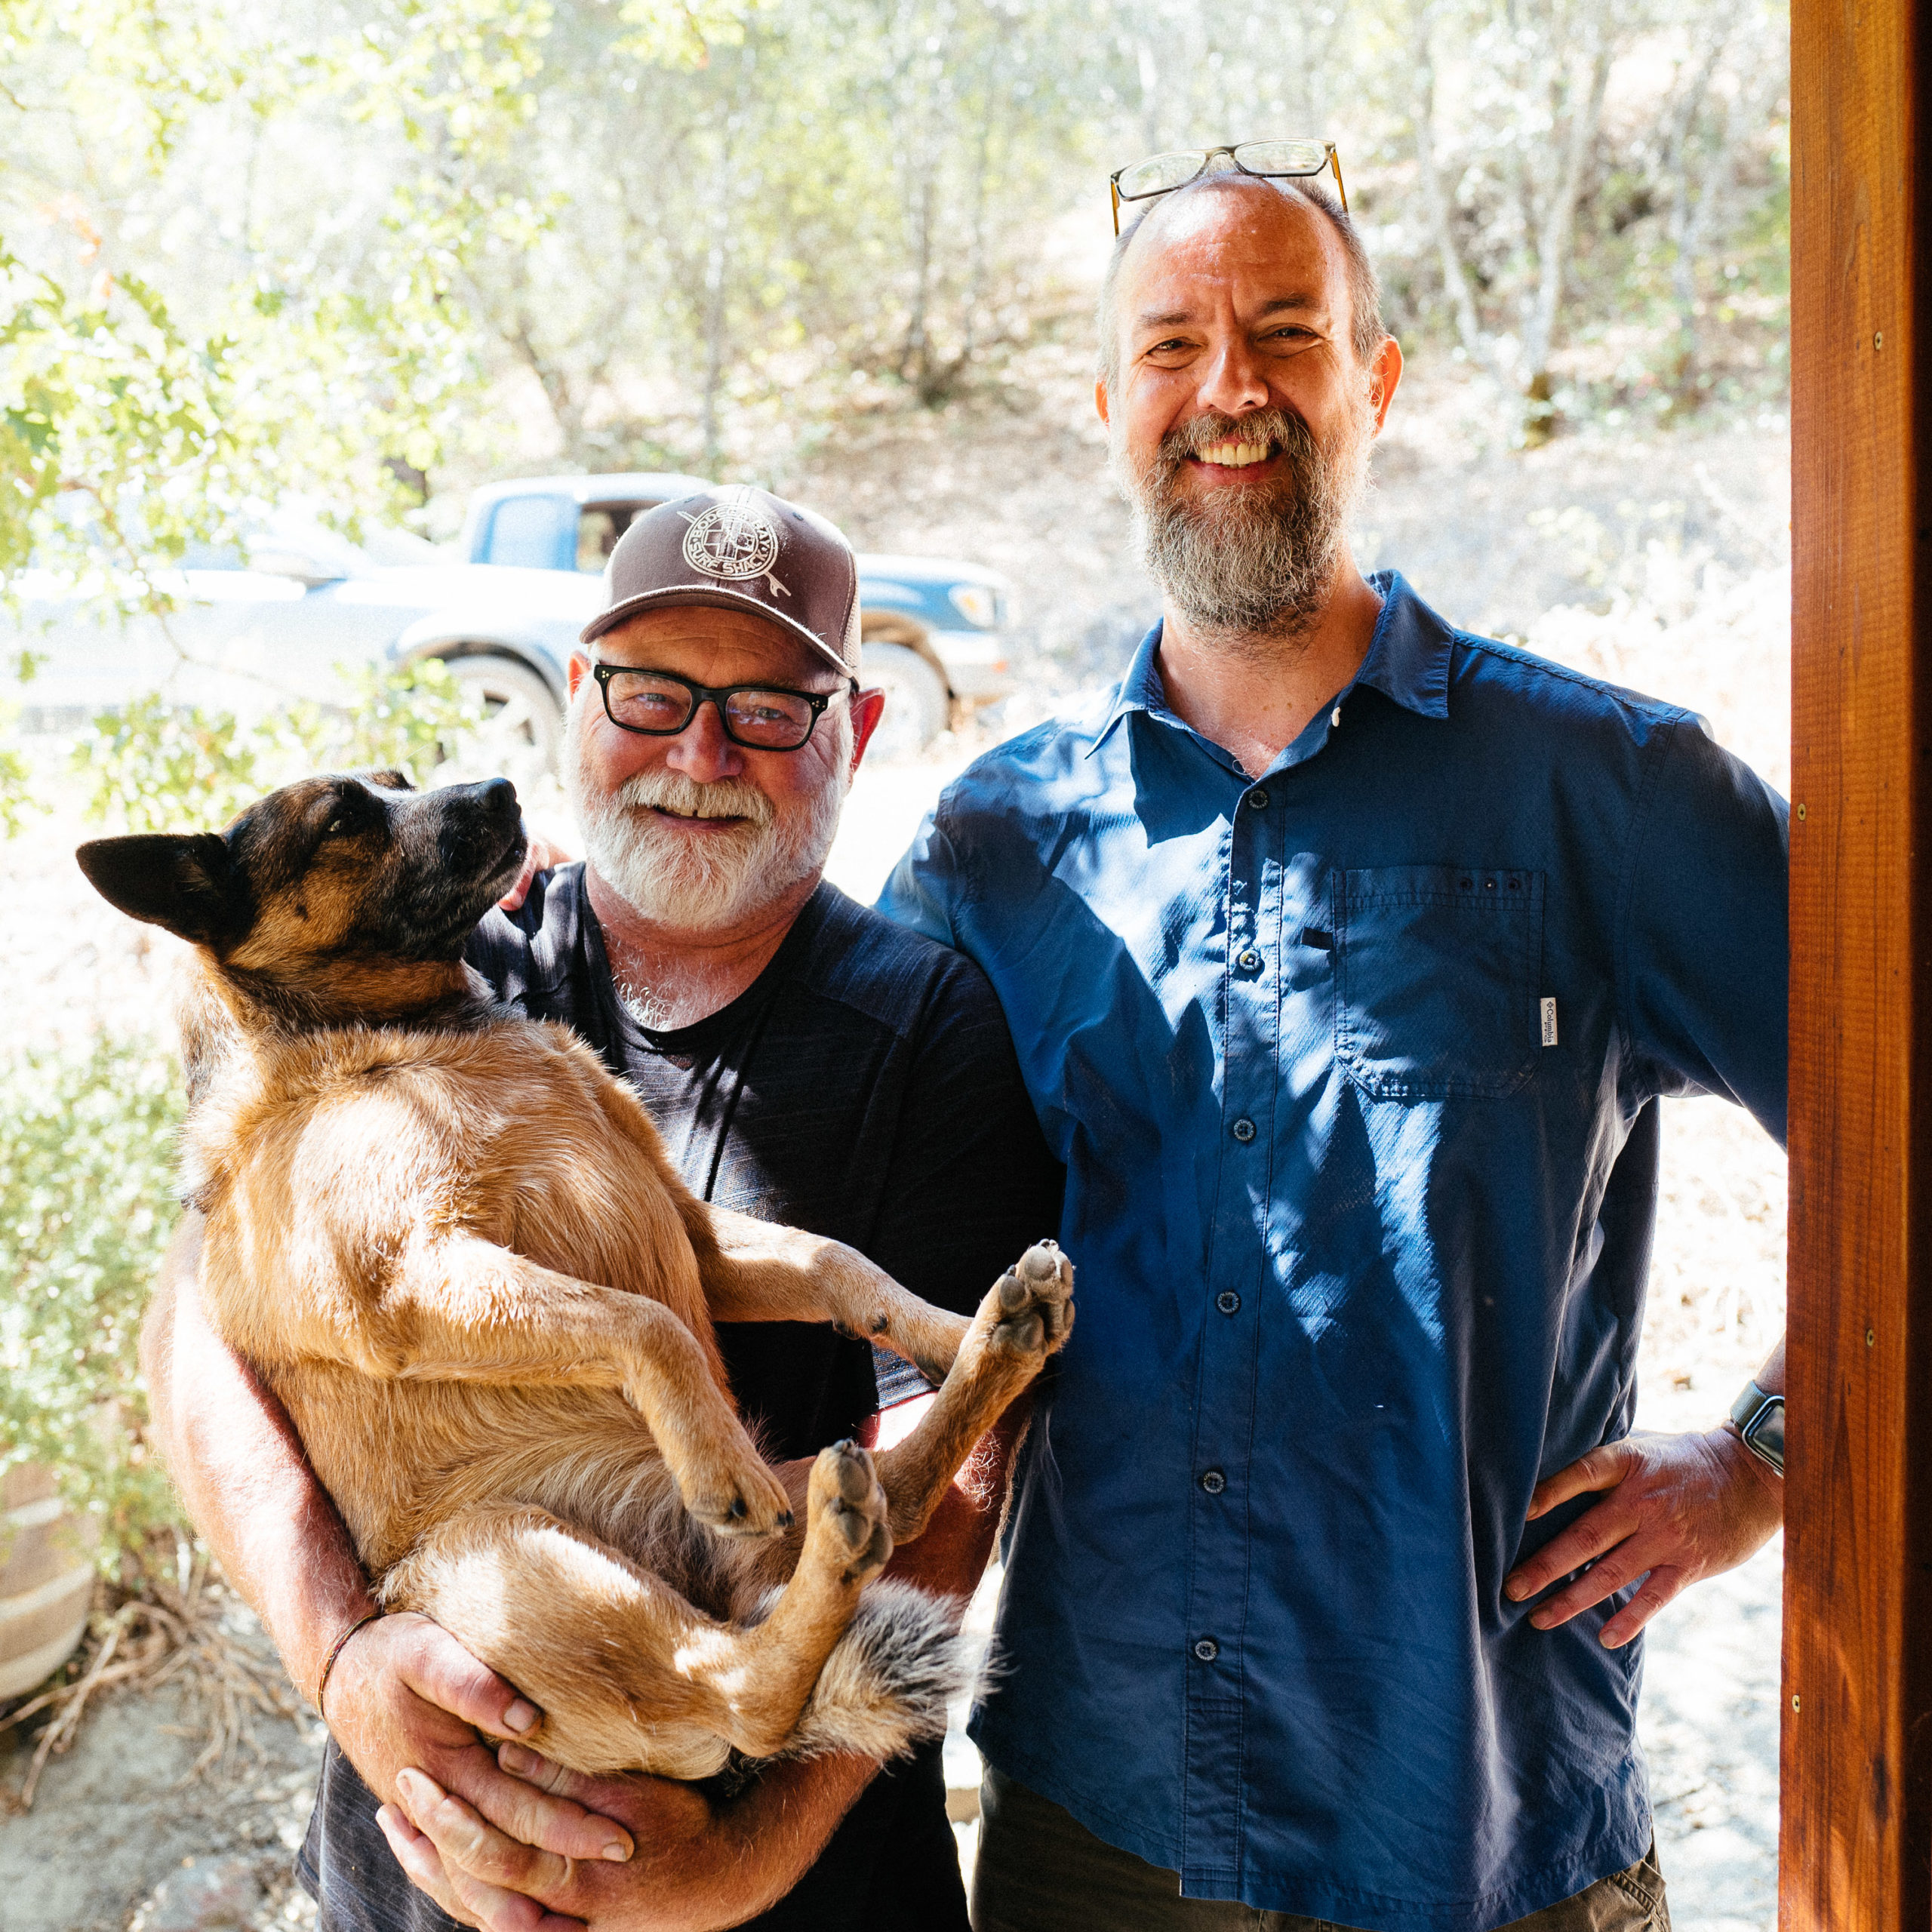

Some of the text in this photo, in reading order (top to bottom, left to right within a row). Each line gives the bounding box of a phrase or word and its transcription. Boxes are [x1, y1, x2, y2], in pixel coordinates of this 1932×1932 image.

[691, 507, 771, 549] BODEGA BAY
[690, 543, 768, 574] SURF SHACK
